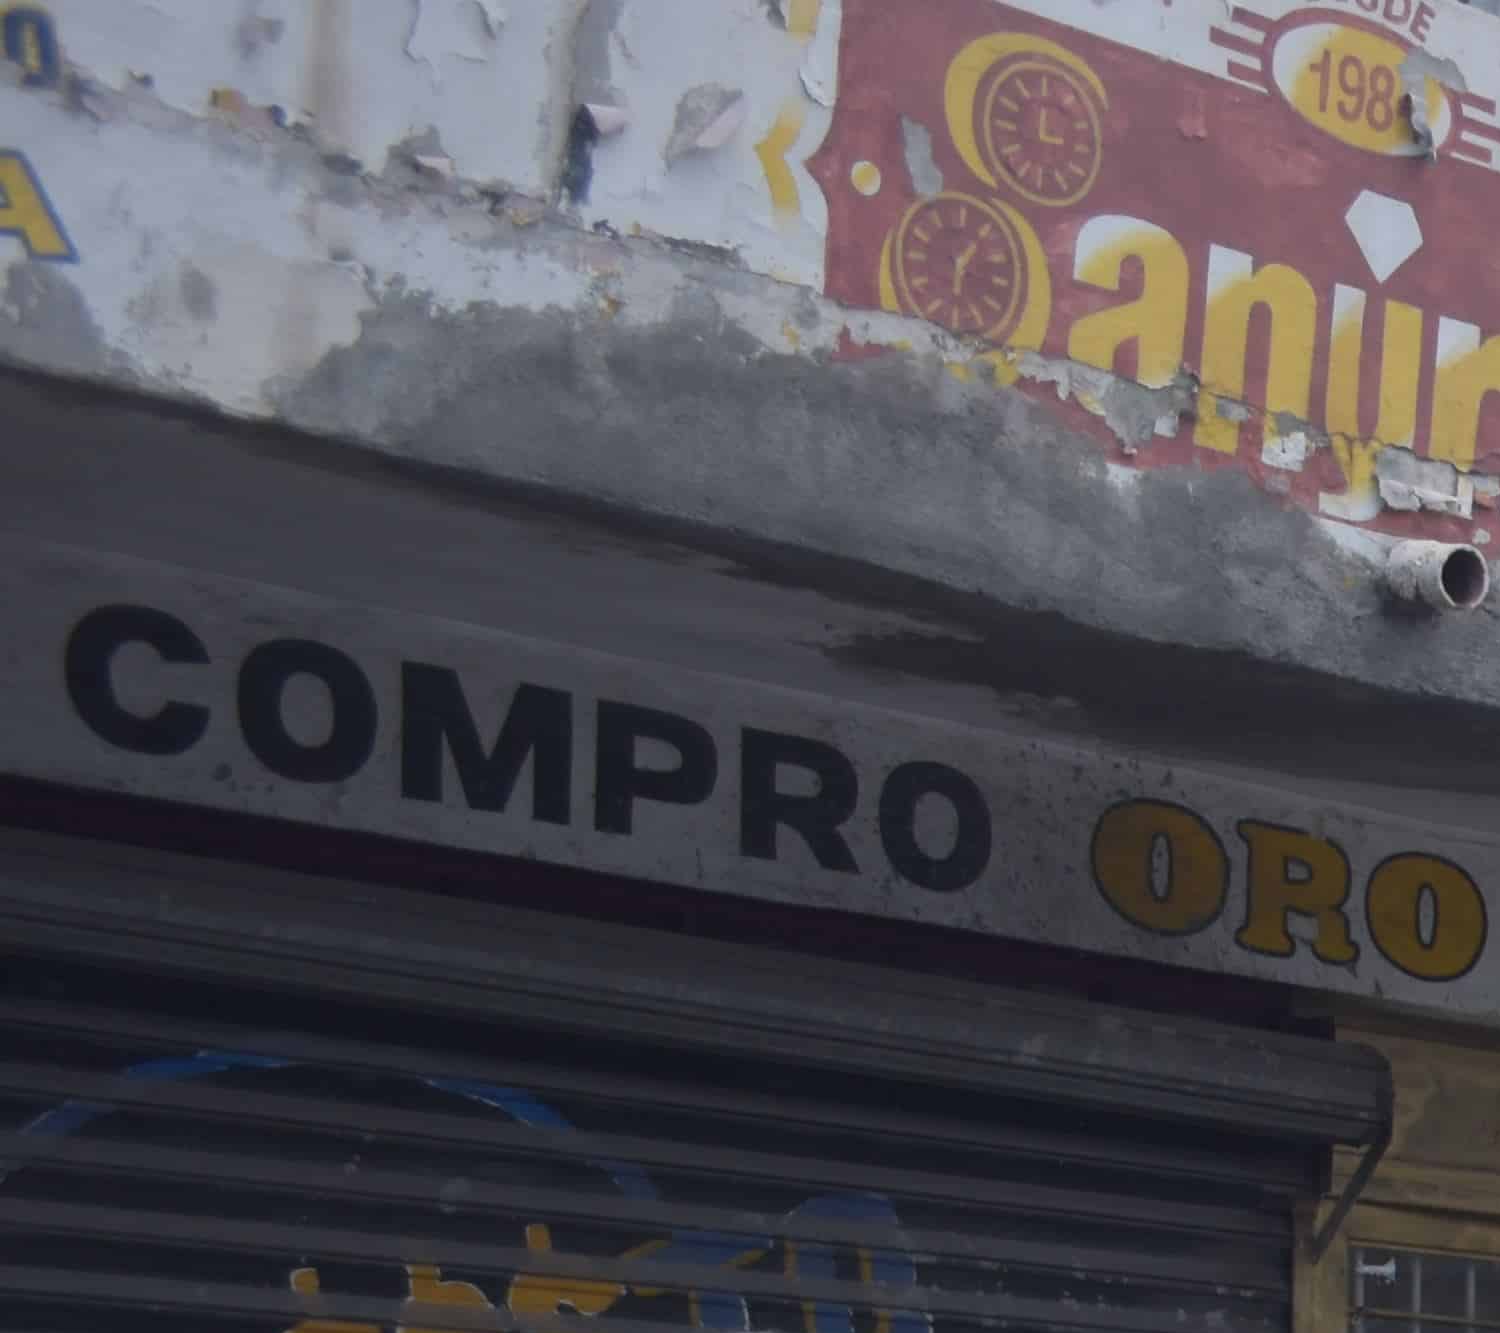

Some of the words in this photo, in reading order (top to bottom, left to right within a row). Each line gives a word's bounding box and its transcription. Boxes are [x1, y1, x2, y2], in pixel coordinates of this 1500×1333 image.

[1307, 47, 1406, 132] 198
[64, 602, 994, 894] COMPRO
[1090, 797, 1488, 982] ORO
